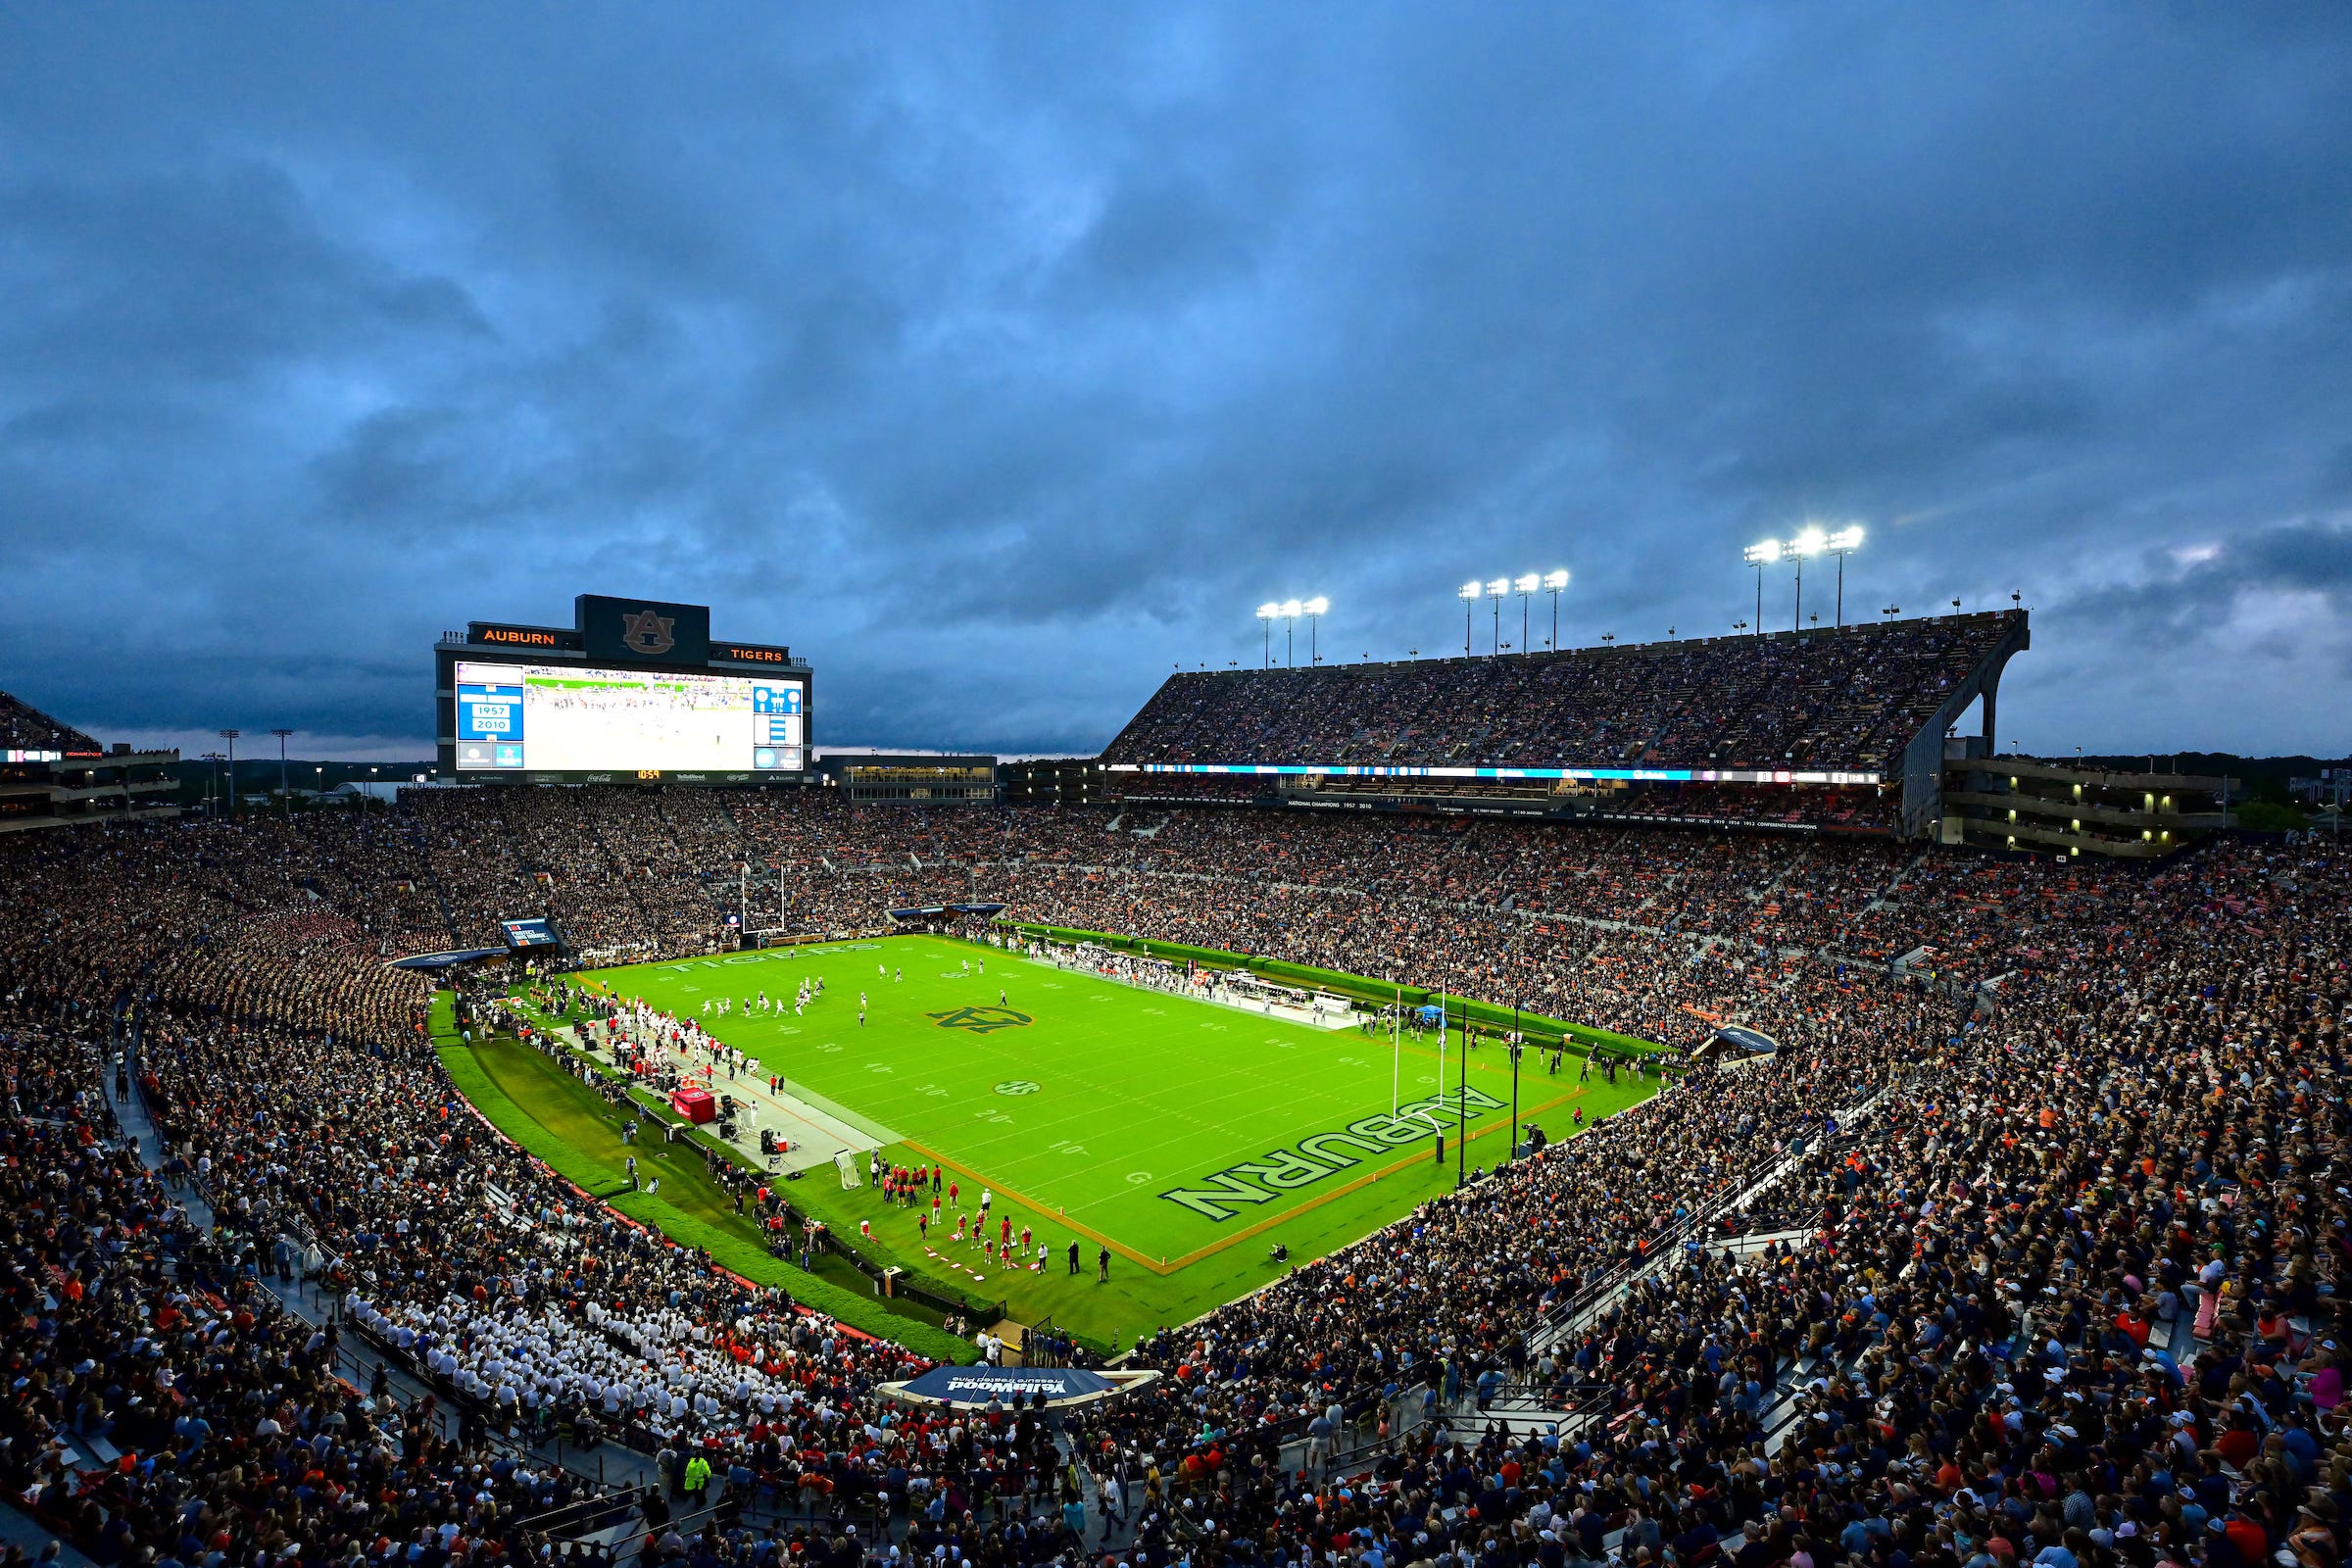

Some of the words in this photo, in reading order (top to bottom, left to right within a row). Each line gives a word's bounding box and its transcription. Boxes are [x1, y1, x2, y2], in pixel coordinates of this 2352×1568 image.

[483, 629, 555, 647] AUBURN
[730, 649, 783, 662] TIGERS
[478, 707, 506, 715] 1957
[477, 720, 506, 729] 2010
[638, 770, 660, 779] 10:59
[655, 943, 885, 973] TIGERS
[914, 1084, 947, 1097] 30
[974, 1109, 1010, 1123] 20
[1049, 1140, 1083, 1154] 10
[1158, 1085, 1510, 1222] AUBURN
[1125, 1171, 1152, 1184] G
